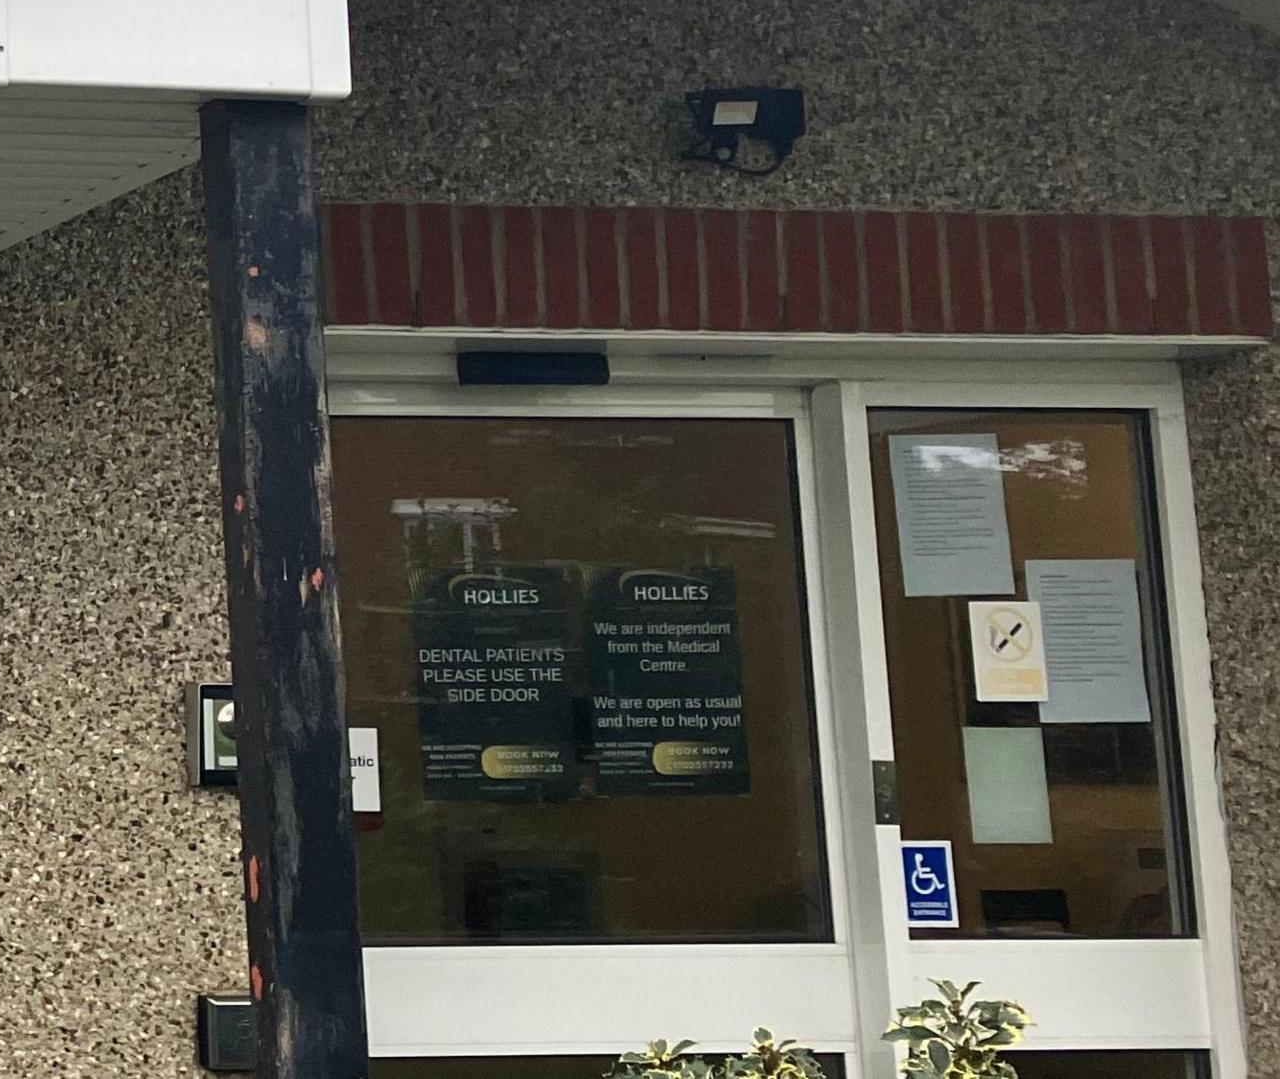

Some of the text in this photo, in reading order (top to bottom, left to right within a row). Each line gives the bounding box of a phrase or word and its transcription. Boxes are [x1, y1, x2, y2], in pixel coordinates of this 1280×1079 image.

[464, 590, 540, 605] HOLLIES
[634, 586, 709, 601] HOLLIES
[594, 622, 731, 637] We are independent
[608, 640, 720, 653] from the Medical
[420, 648, 565, 663] DENTAL PATIENTS
[423, 668, 563, 683] PLEASE USE THE
[448, 688, 540, 703] SIDE DOOR
[593, 696, 742, 711] We are open as usual
[597, 715, 623, 728] and
[626, 714, 658, 728] here
[662, 715, 675, 728] to
[678, 714, 709, 730] help
[702, 746, 731, 755] NOW
